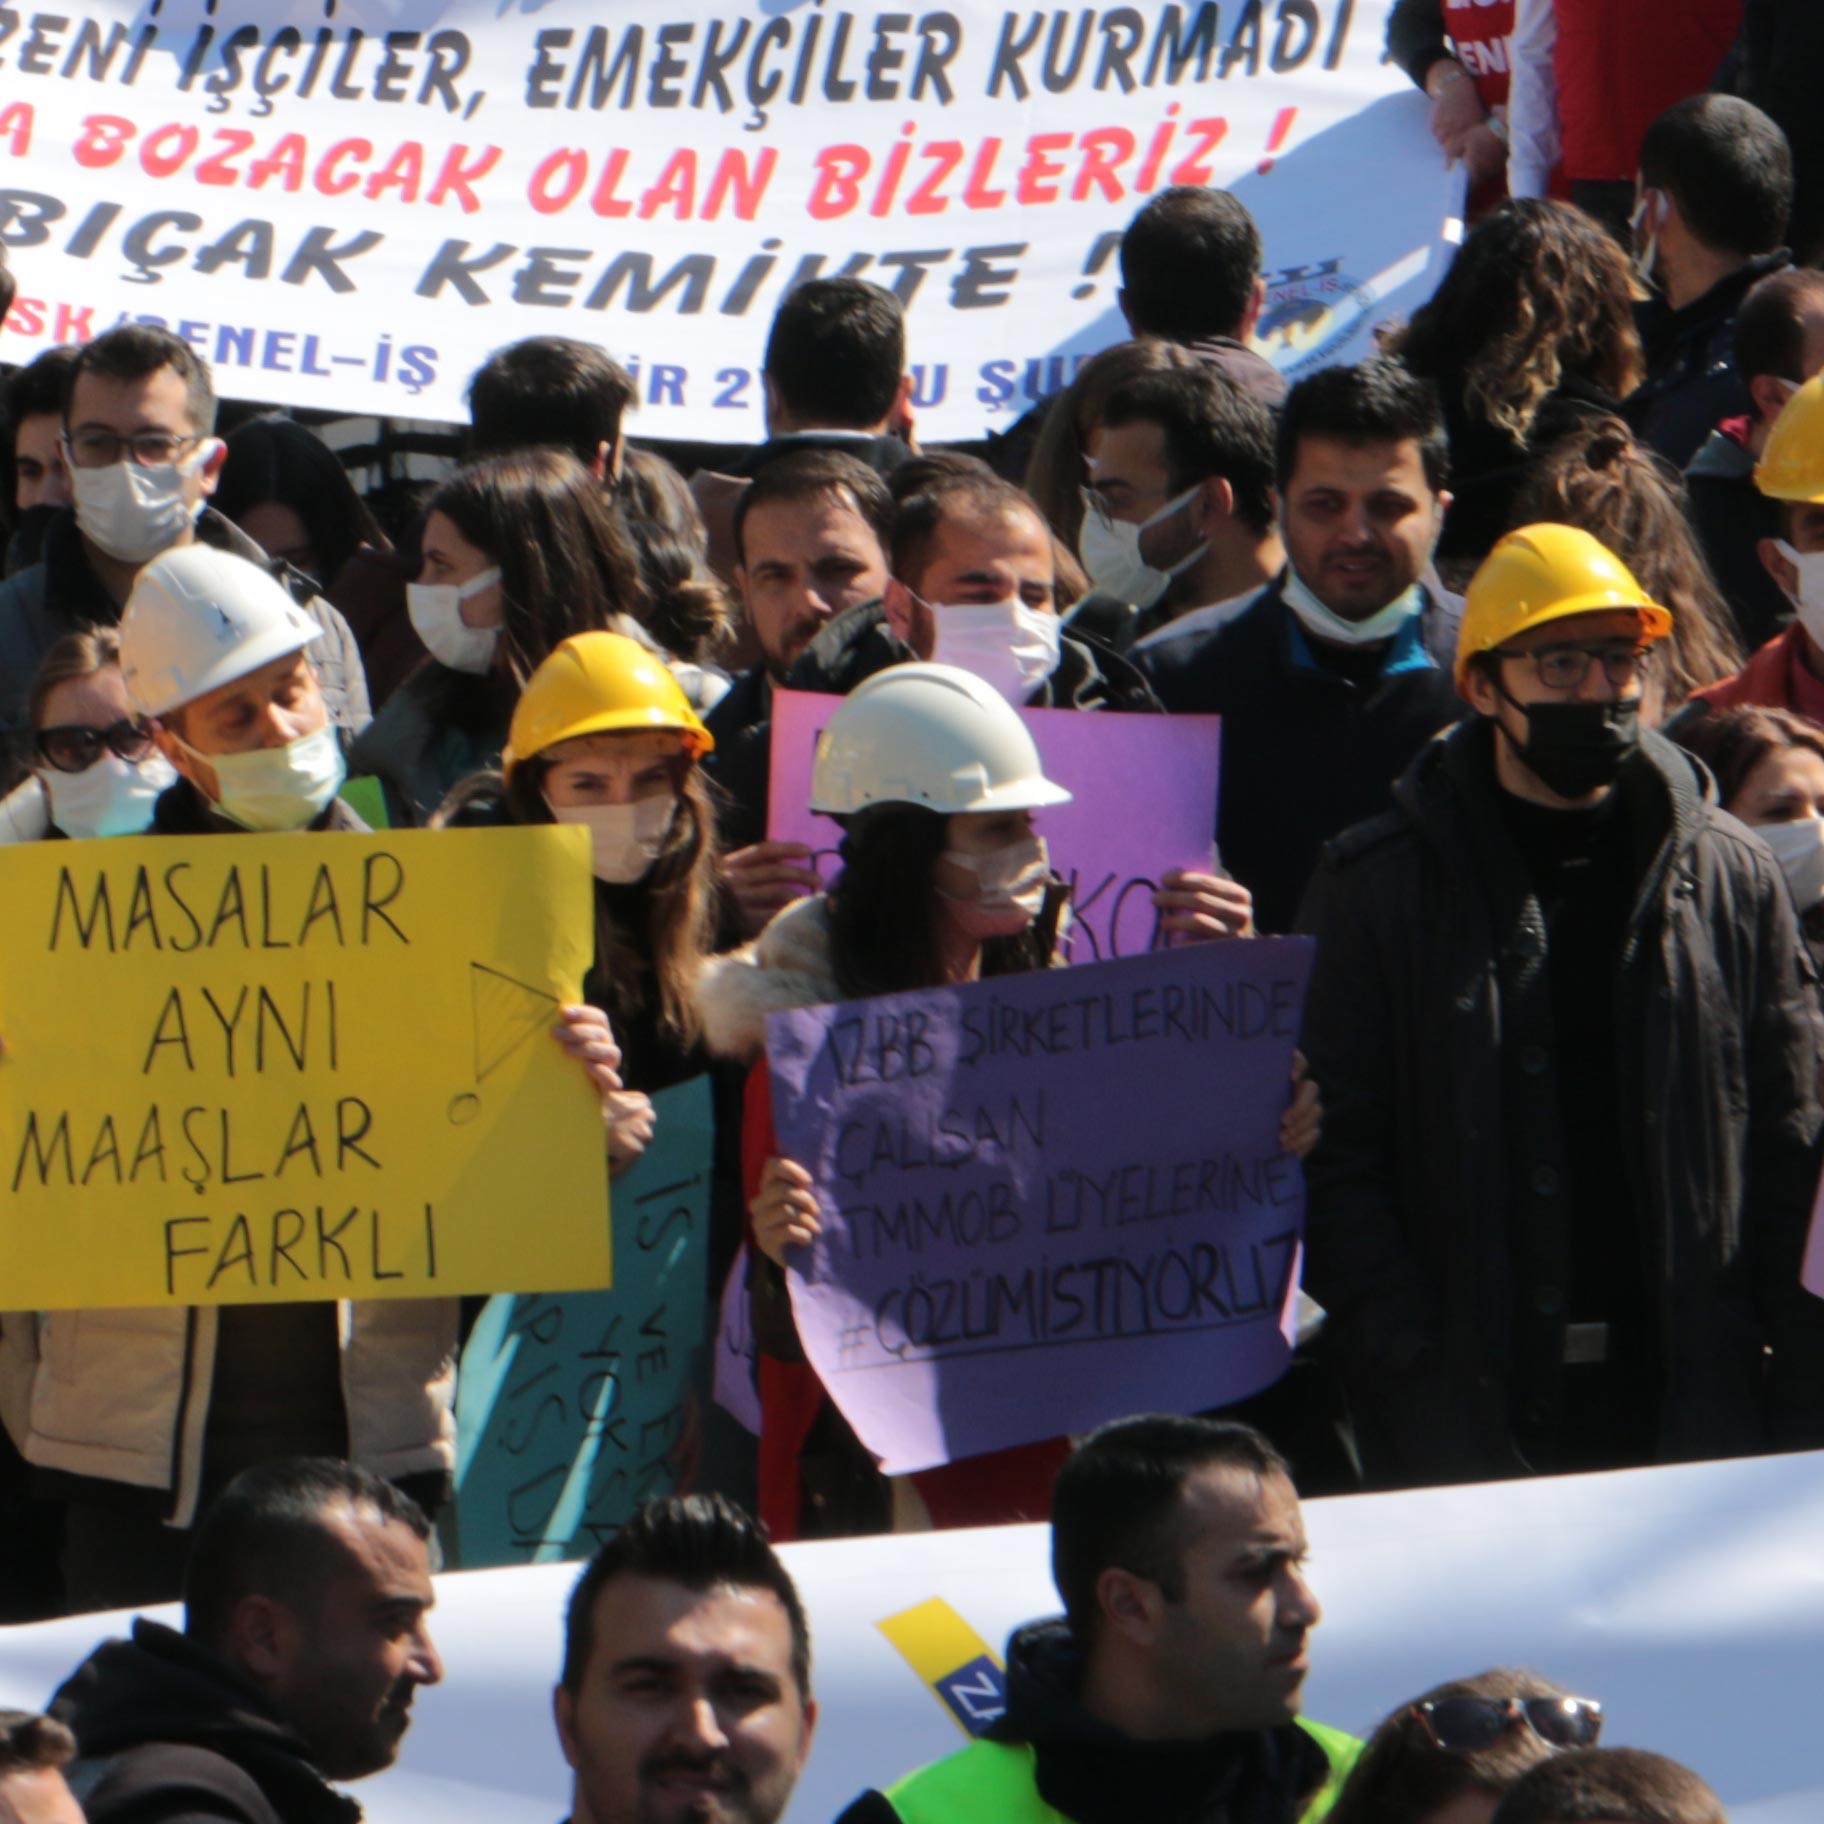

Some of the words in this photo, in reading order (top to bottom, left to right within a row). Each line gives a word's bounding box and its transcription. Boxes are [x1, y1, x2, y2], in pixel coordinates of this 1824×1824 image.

[72, 113, 504, 215] BOZACAK
[526, 145, 778, 222] OLAN
[806, 102, 1229, 223] BİZLERİZ
[48, 851, 411, 954] MASALAR
[142, 979, 339, 1078] AYNI
[11, 1096, 383, 1196] MAAŞLAR
[164, 1202, 439, 1295] FARKLI
[842, 1184, 1022, 1261] TMMOB
